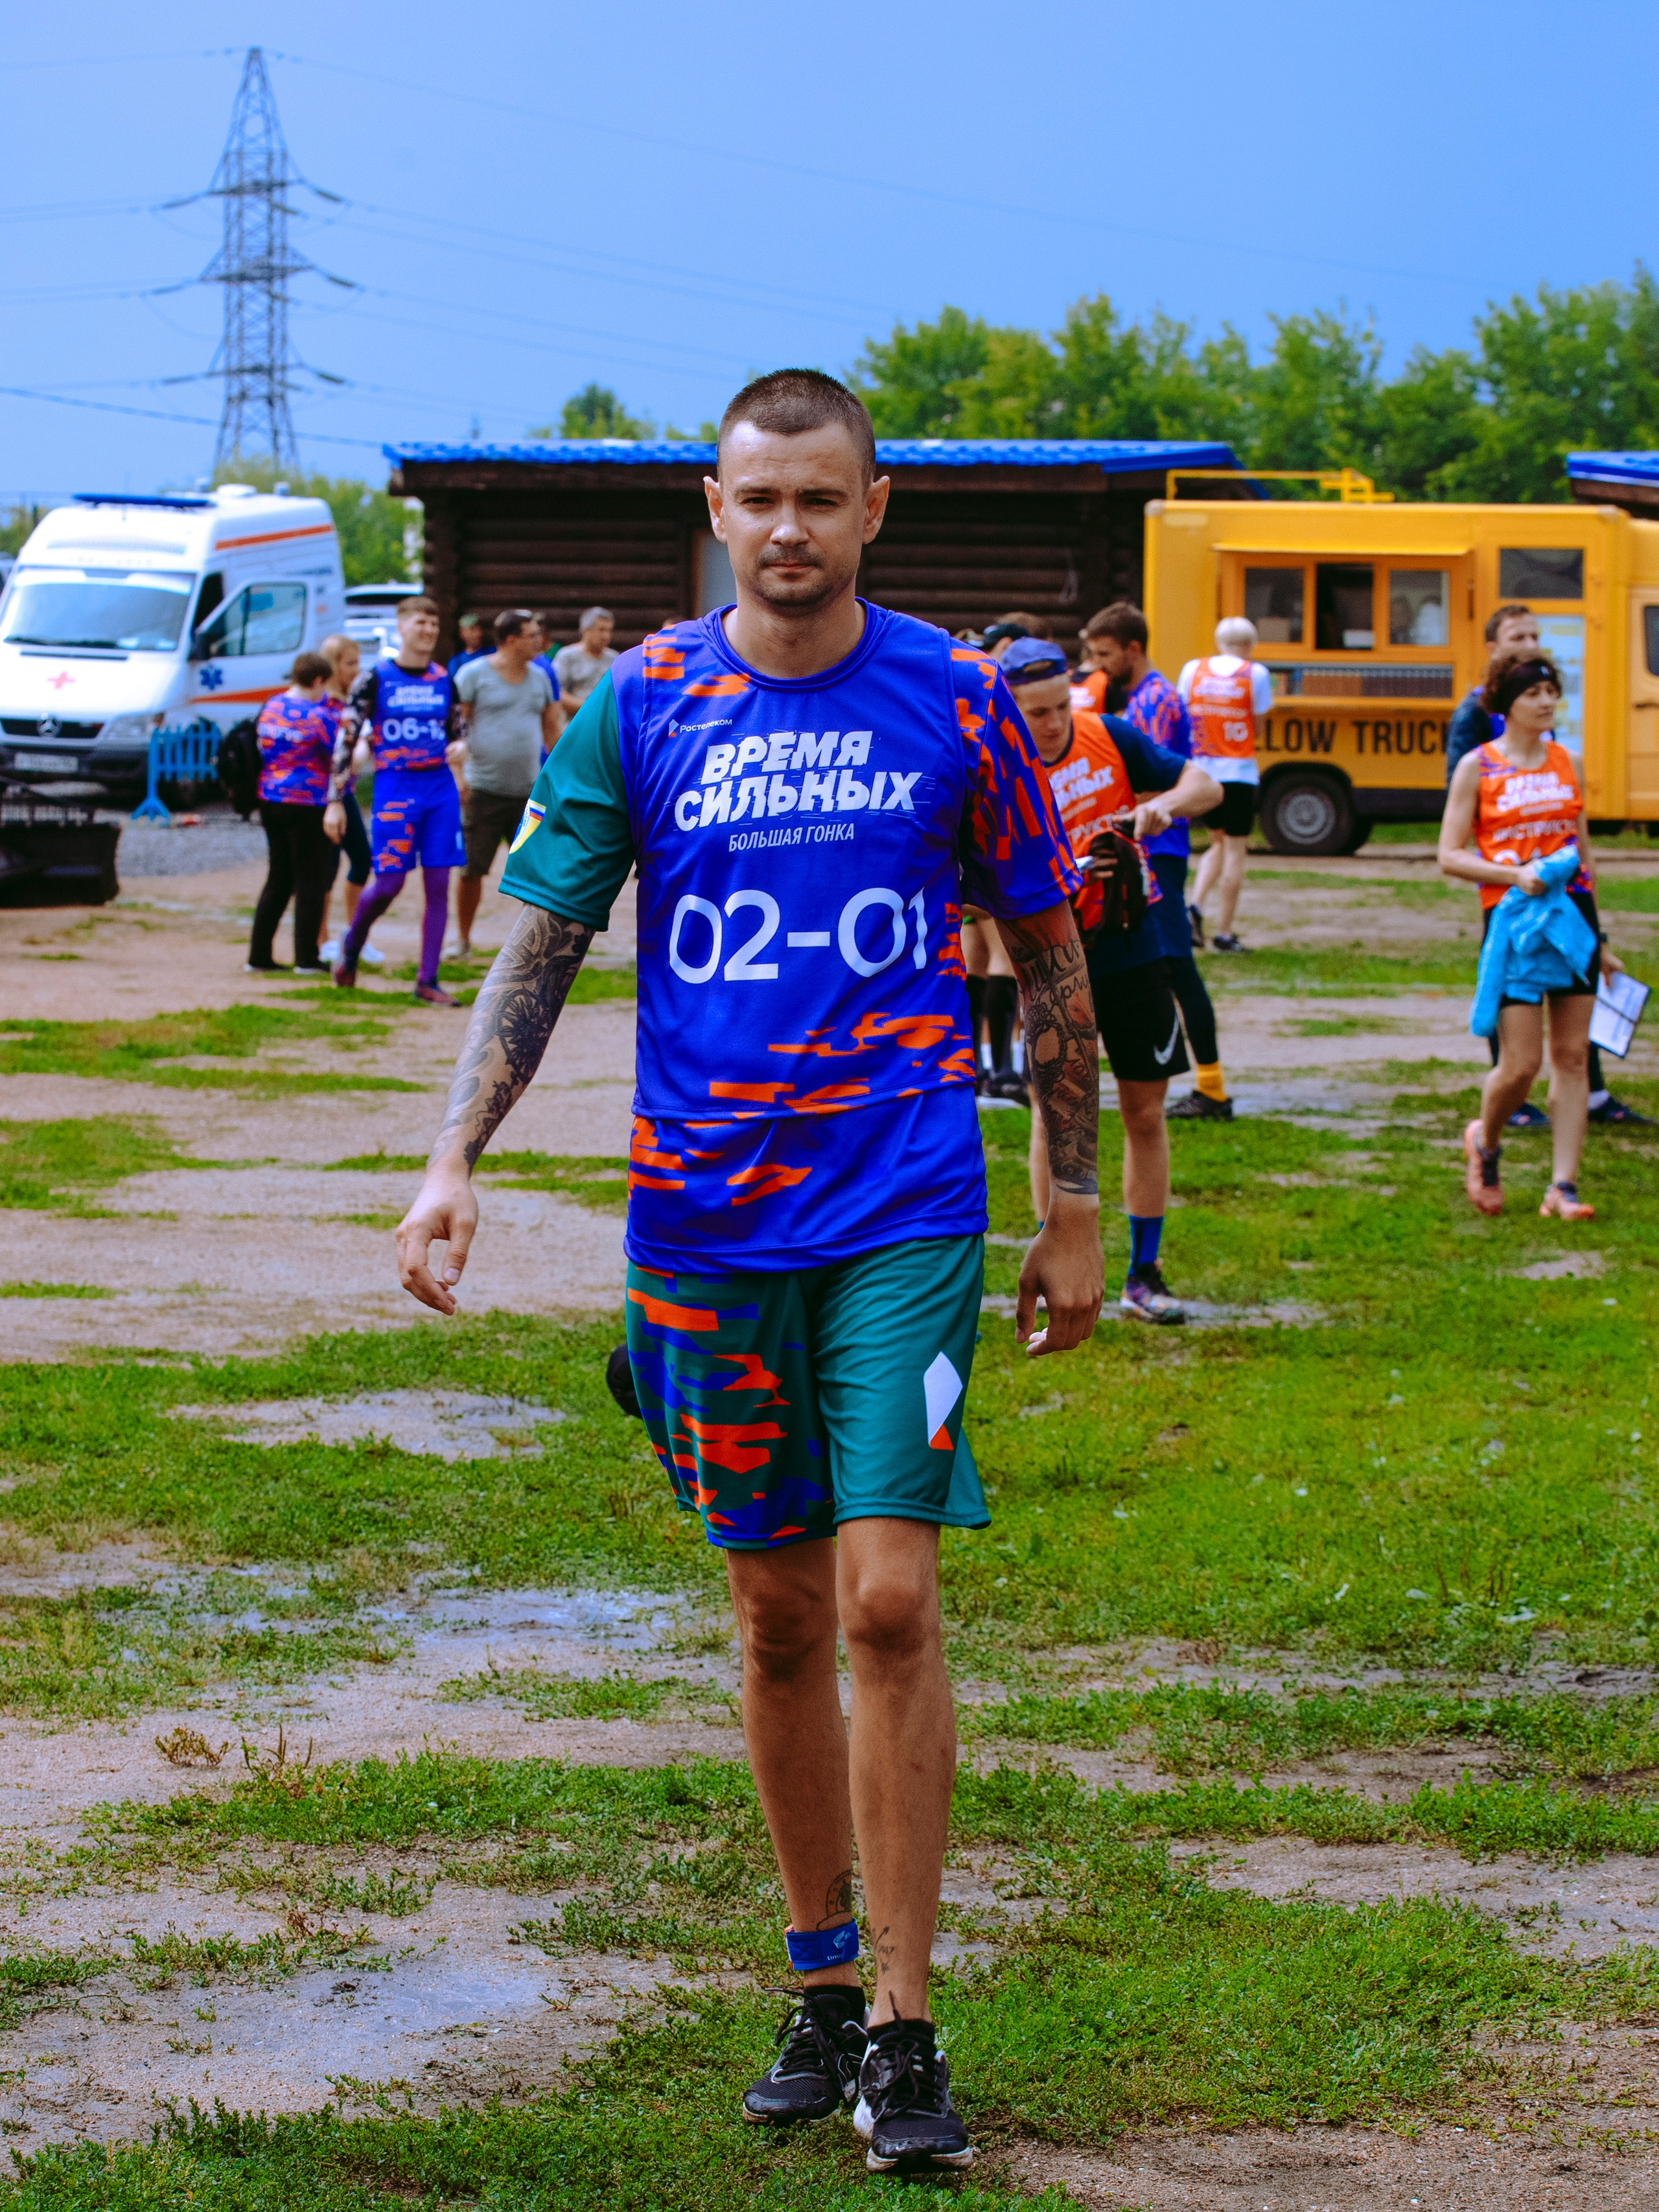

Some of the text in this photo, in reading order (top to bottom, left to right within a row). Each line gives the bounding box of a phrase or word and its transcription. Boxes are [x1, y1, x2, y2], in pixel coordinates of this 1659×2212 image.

[680, 719, 733, 734] Ростелеком
[1256, 719, 1337, 752] LOW
[701, 730, 873, 785] ВРЕМЯ
[674, 769, 923, 832] СИЛЬНЫХ
[728, 822, 855, 852] БОЛЬШАЯ ГОНКА
[669, 887, 928, 984] 02-01
